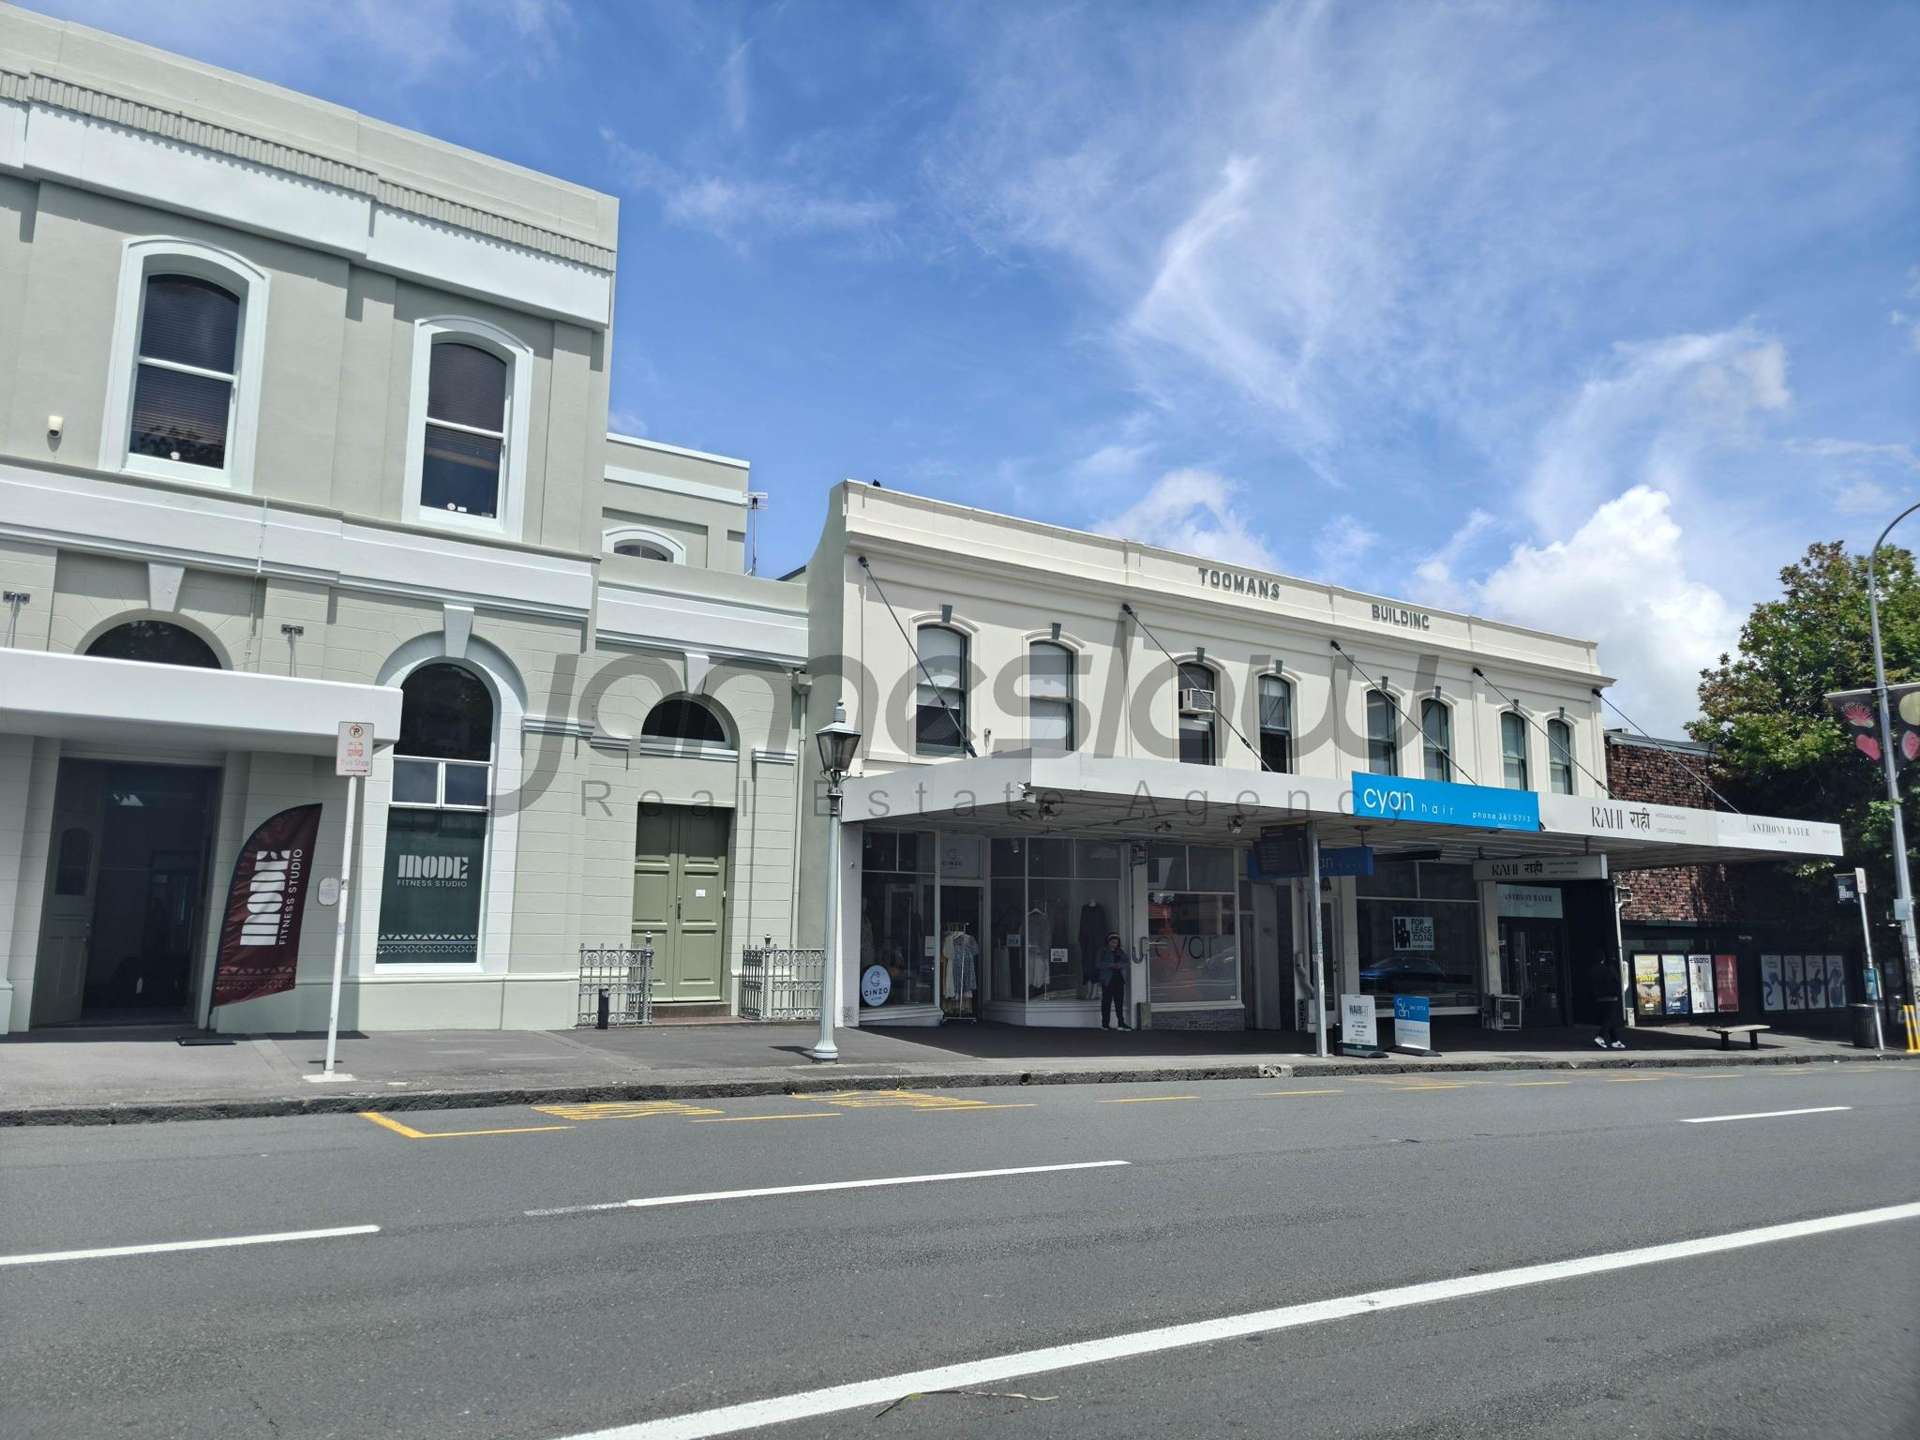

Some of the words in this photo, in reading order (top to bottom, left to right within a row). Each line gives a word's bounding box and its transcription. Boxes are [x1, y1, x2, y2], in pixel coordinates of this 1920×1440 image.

[1363, 787, 1415, 815] cyan
[1420, 802, 1455, 816] hair
[1591, 806, 1623, 830] RAHI
[398, 854, 469, 880] MODE
[396, 879, 433, 888] FITNESS
[434, 880, 468, 888] STUDIO
[240, 850, 292, 946] MODE
[278, 894, 296, 946] FITNESS
[288, 848, 303, 894] STUDIO
[863, 987, 889, 998] CINZO
